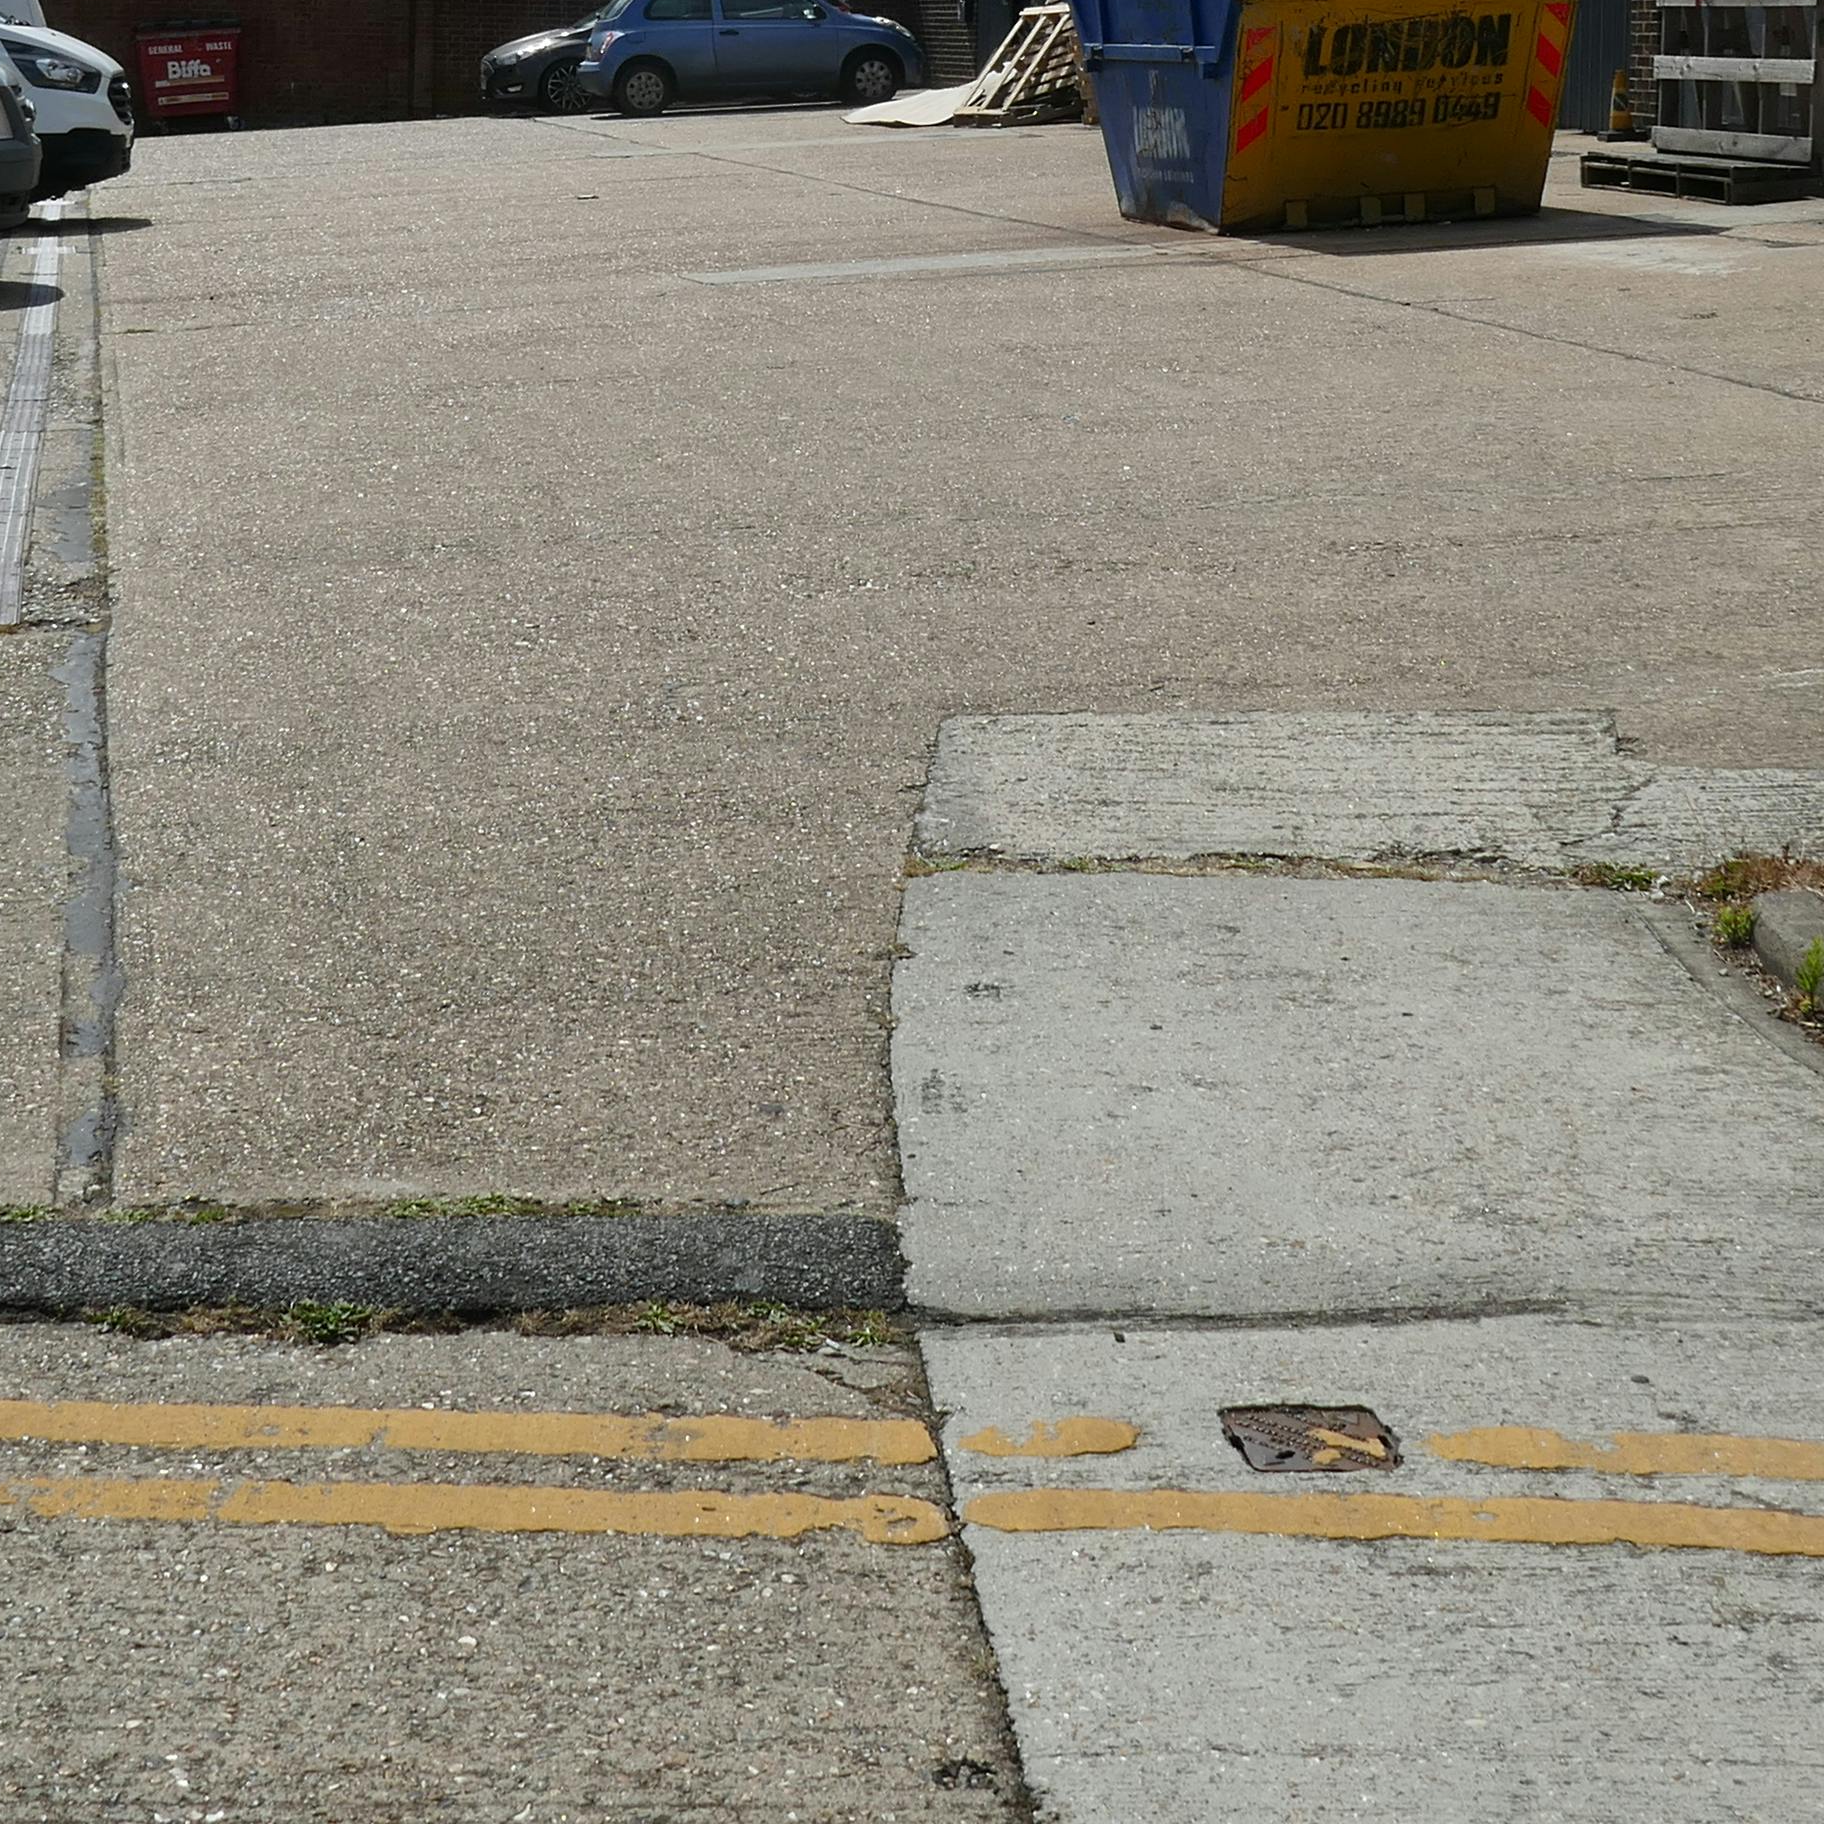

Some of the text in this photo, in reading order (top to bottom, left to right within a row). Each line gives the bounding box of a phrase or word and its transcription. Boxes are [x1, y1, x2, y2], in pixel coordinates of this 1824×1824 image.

[148, 40, 233, 55] GENERAL WASTE
[1304, 12, 1513, 77] LONDON
[166, 59, 212, 80] Biffa
[1296, 102, 1348, 130] 020
[1356, 97, 1426, 129] 8989
